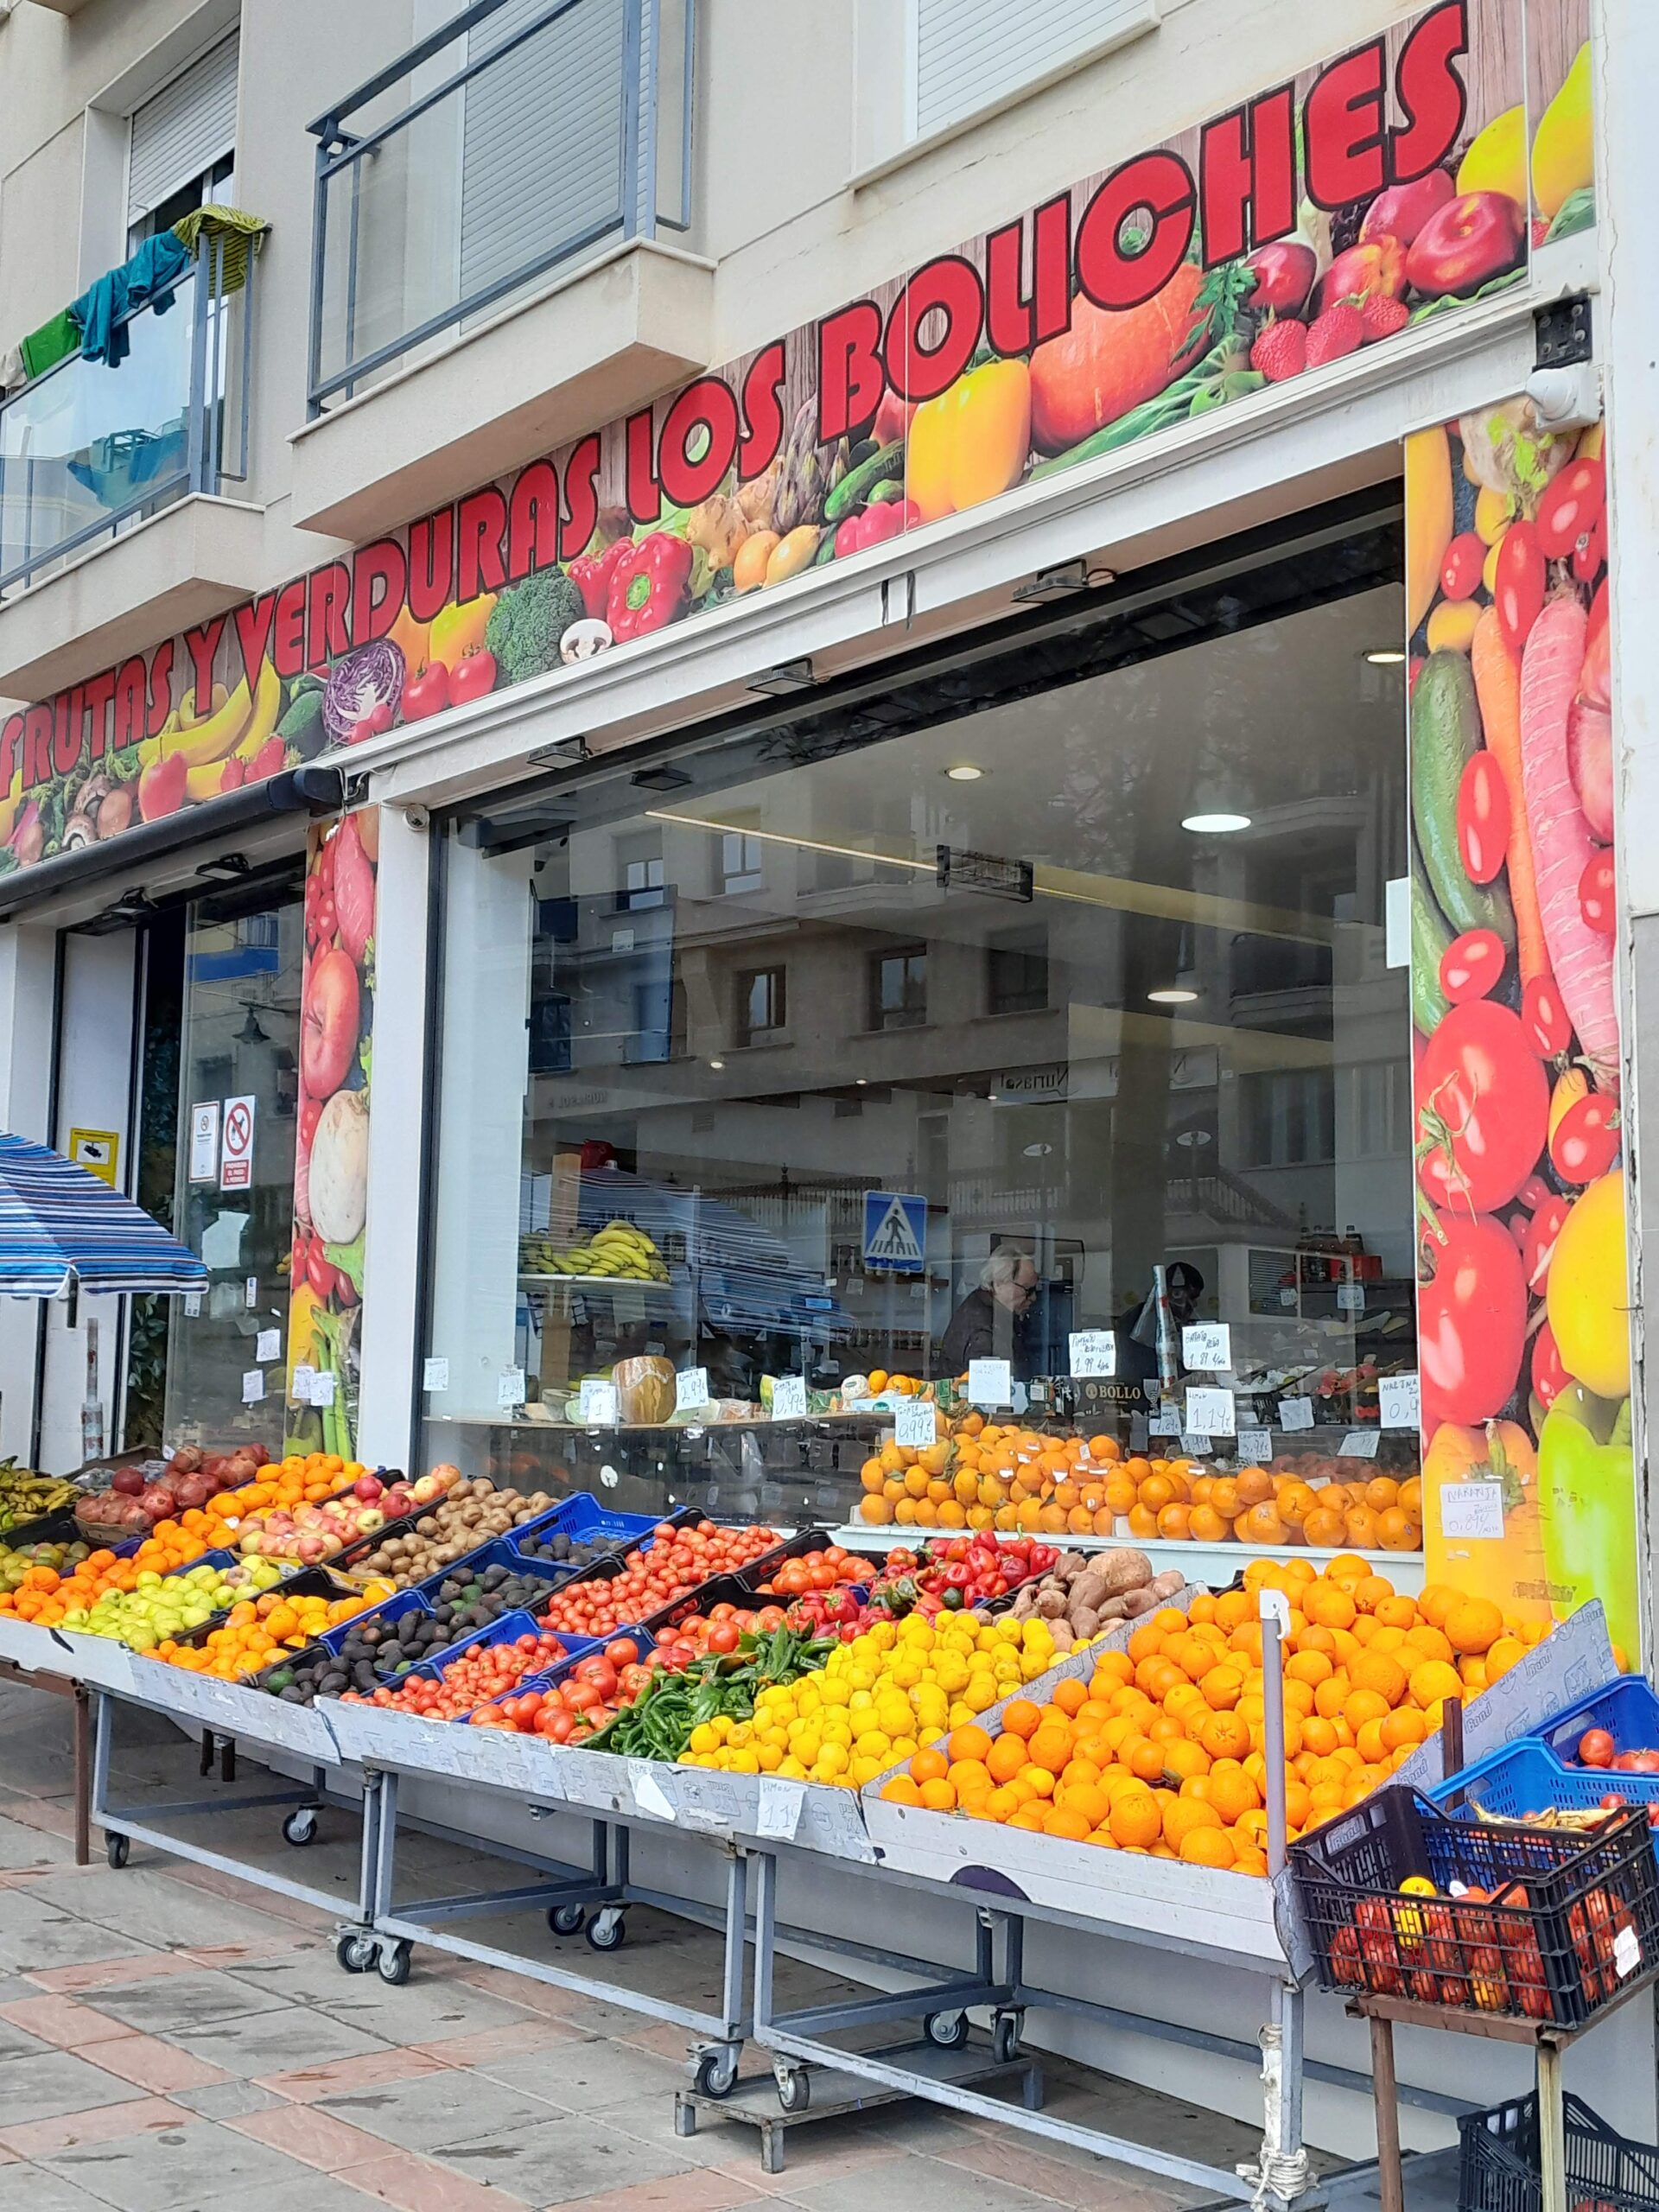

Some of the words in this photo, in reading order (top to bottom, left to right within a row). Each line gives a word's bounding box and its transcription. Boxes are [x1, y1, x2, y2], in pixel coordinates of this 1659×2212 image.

[0, 638, 175, 800] FRUTAS
[183, 613, 228, 718] Y
[233, 433, 602, 702] VERDURAS
[625, 339, 786, 525] LOS
[817, 0, 1469, 448] BOLICHES
[1099, 1384, 1141, 1400] BOLLO
[1466, 1702, 1493, 1733] Bond
[1332, 1818, 1362, 1852] Bond
